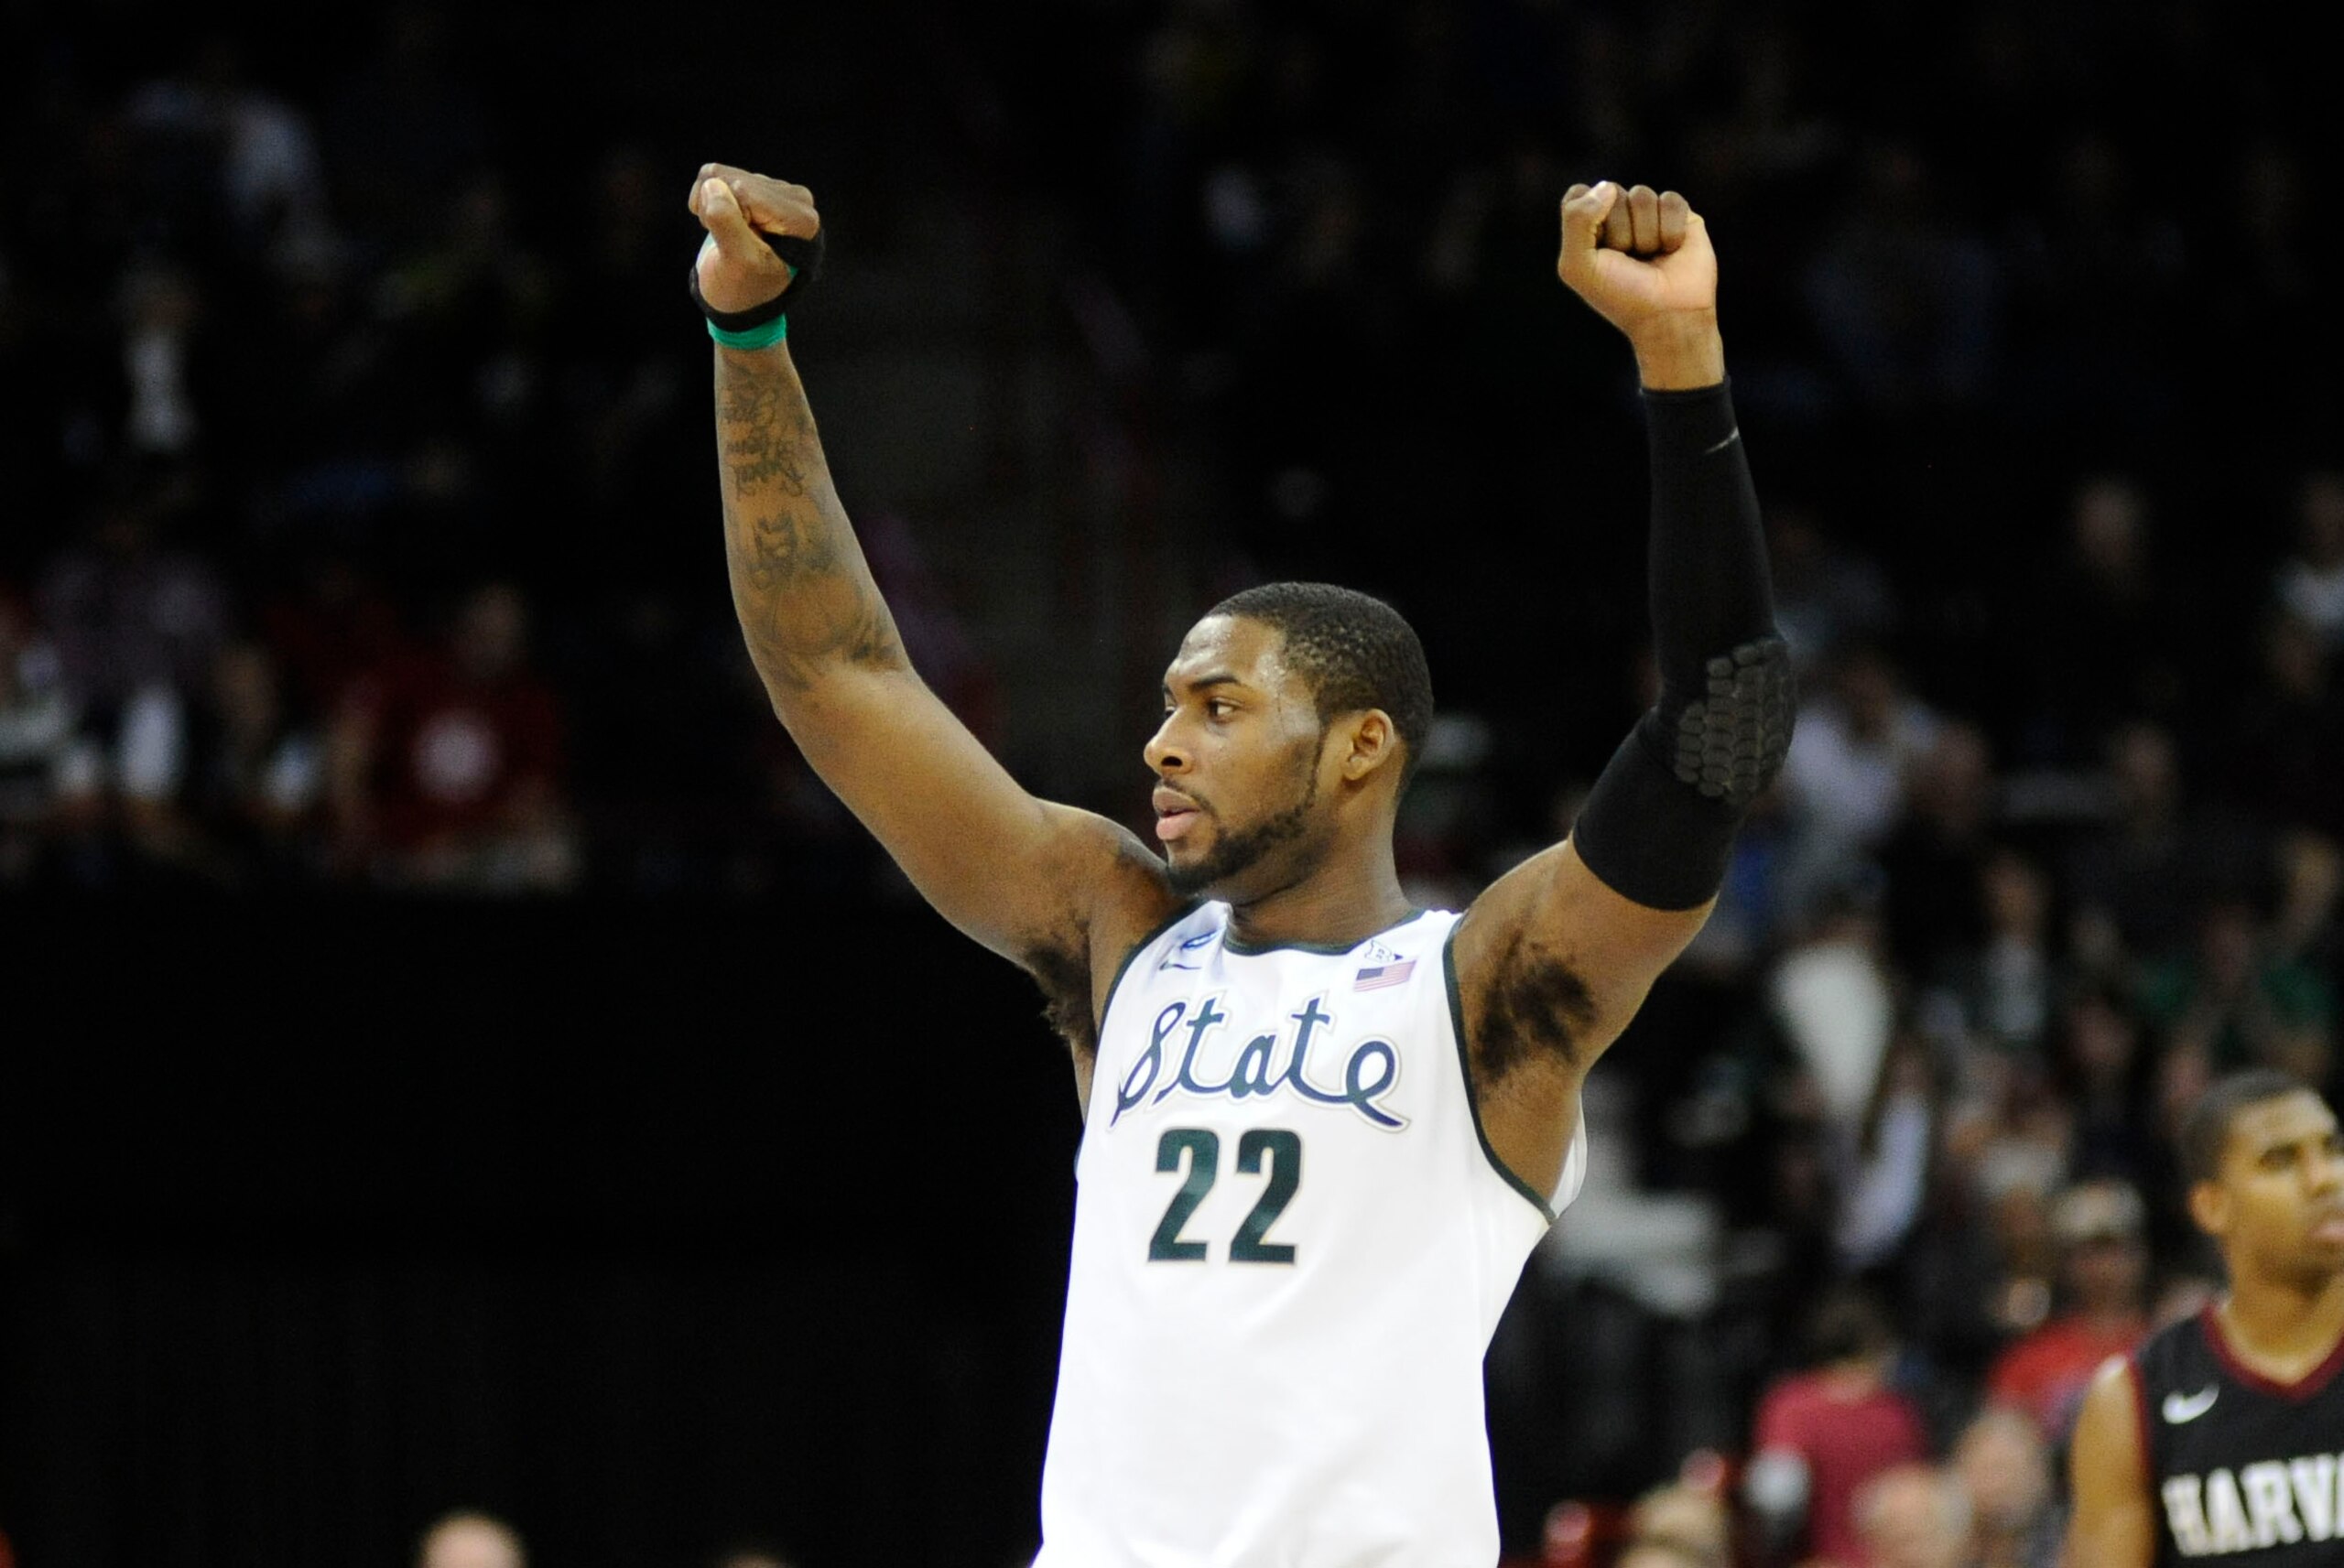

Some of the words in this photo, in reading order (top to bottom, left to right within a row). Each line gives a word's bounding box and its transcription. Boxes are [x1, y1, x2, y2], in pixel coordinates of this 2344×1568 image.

[1108, 994, 1407, 1130] State
[1148, 1128, 1303, 1263] 22
[2160, 1451, 2344, 1557] HARV
